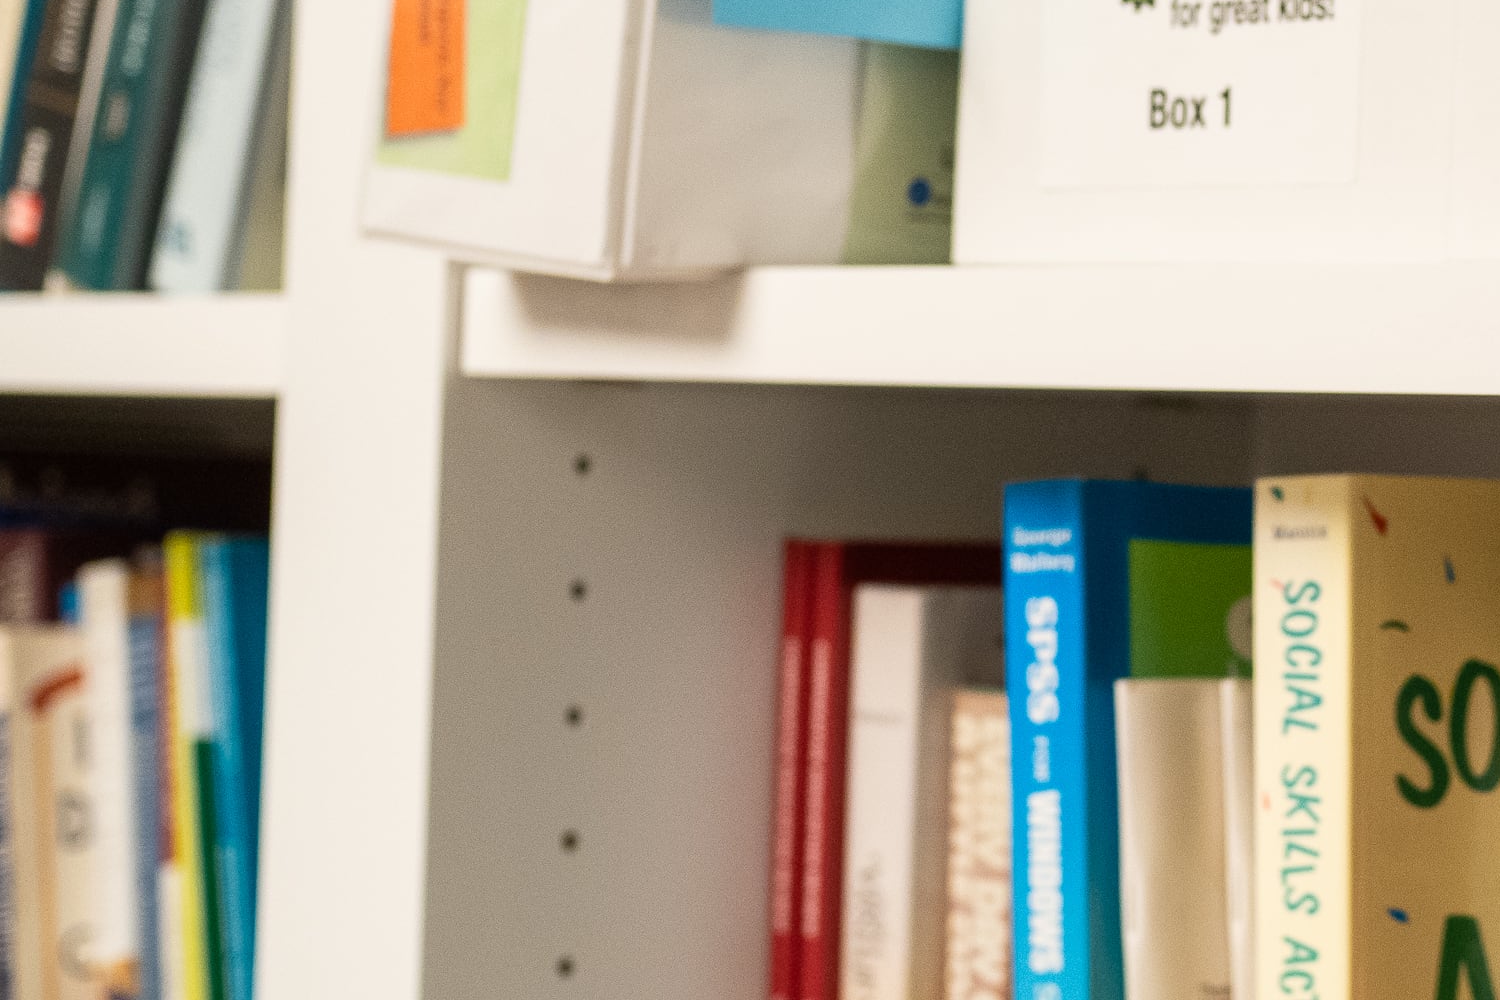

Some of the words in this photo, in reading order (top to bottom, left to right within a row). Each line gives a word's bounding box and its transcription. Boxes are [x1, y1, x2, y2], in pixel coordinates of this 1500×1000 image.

[1149, 87, 1206, 130] Box
[1220, 86, 1232, 126] 1
[1025, 596, 1059, 724] SPSS
[1280, 579, 1323, 735] SOCIAL
[1027, 789, 1065, 974] WINDOWS
[1280, 765, 1321, 915] SKILLS
[1278, 935, 1320, 1000] AC
